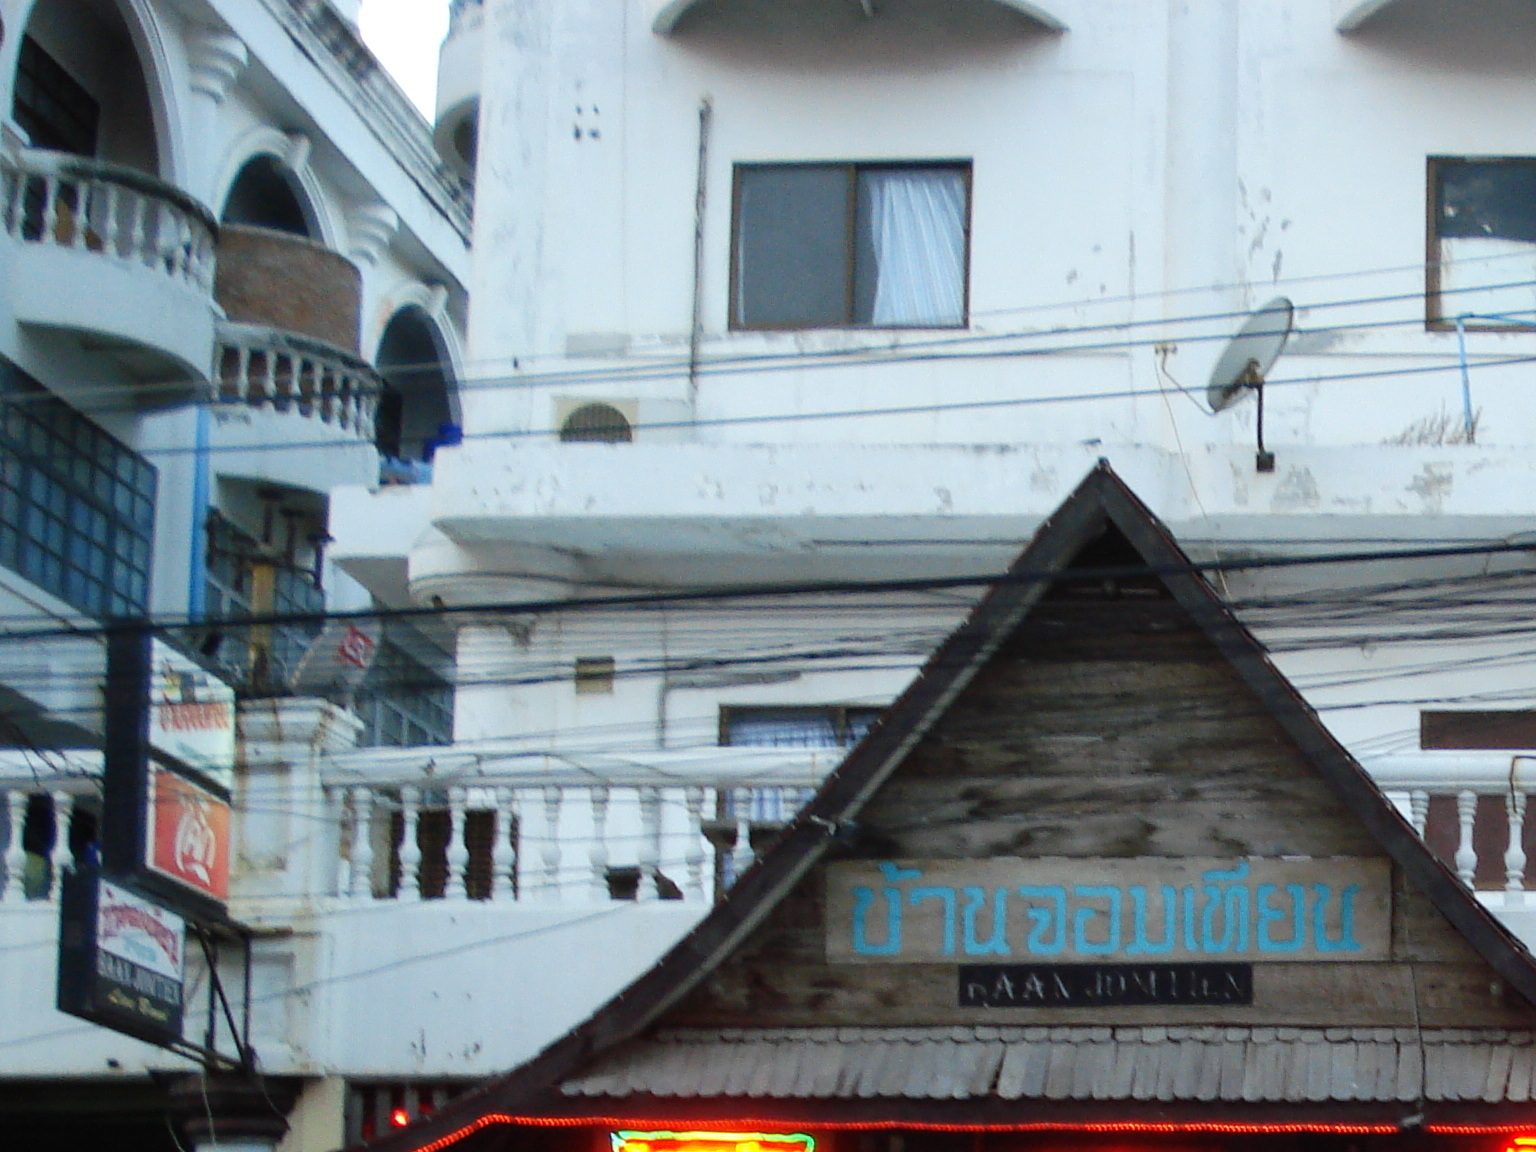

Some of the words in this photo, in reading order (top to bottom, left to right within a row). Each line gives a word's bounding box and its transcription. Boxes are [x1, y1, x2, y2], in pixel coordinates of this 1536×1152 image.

[851, 860, 1362, 956] บ้านจอมเทียน
